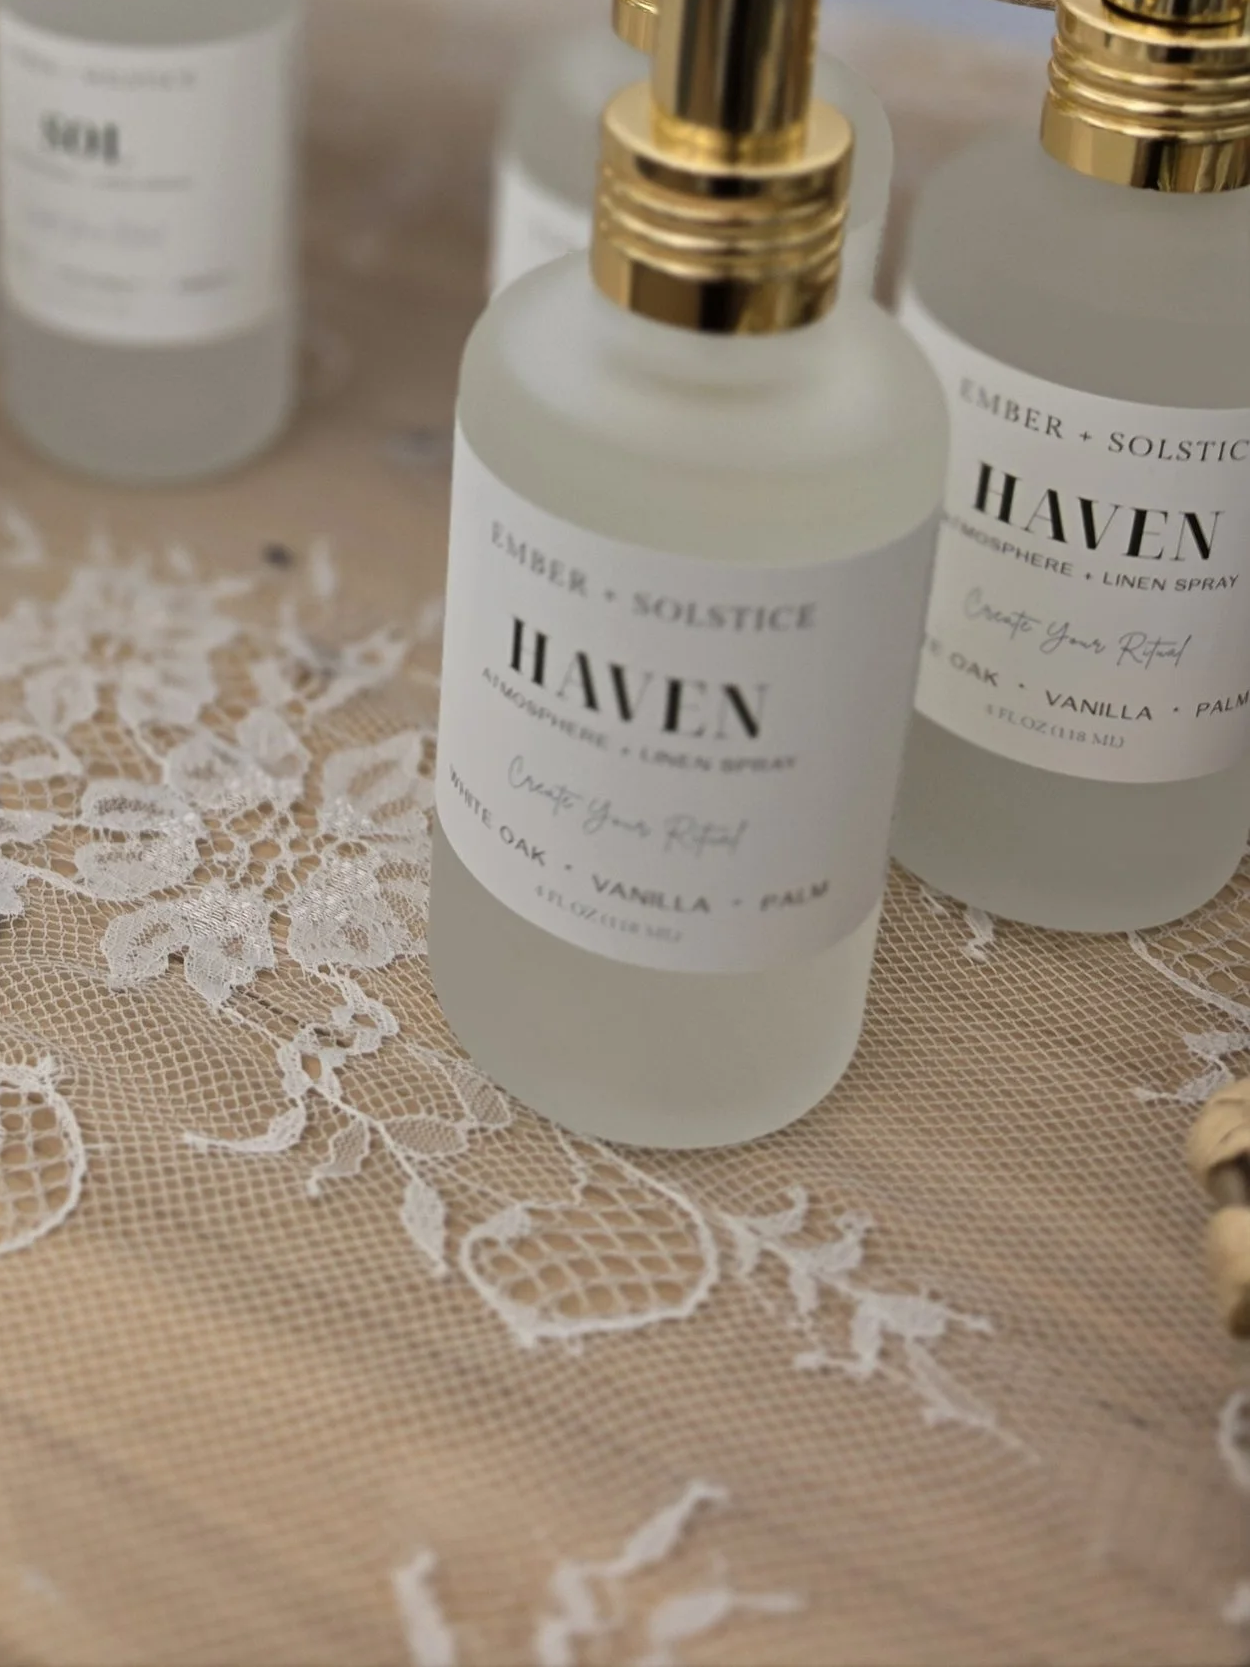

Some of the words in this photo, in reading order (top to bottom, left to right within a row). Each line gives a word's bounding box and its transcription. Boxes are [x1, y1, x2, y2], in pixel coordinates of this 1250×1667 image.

[958, 377, 1064, 440] EMBER
[970, 459, 1227, 562] HAVEN
[491, 519, 588, 598] EMBER
[632, 590, 818, 633] SOLSTICE
[1102, 571, 1168, 592] LINEN
[1173, 573, 1240, 592] SPRAY
[964, 584, 1042, 640] Create
[1039, 620, 1106, 656] Your
[1116, 631, 1192, 670] Ritual
[509, 613, 772, 741] HAVEN
[946, 650, 999, 687] OAK
[1044, 688, 1154, 722] VANILLA
[1195, 688, 1250, 718] PALM
[508, 754, 584, 816] Create
[498, 824, 546, 867] OAK
[592, 872, 712, 914] VANILLA
